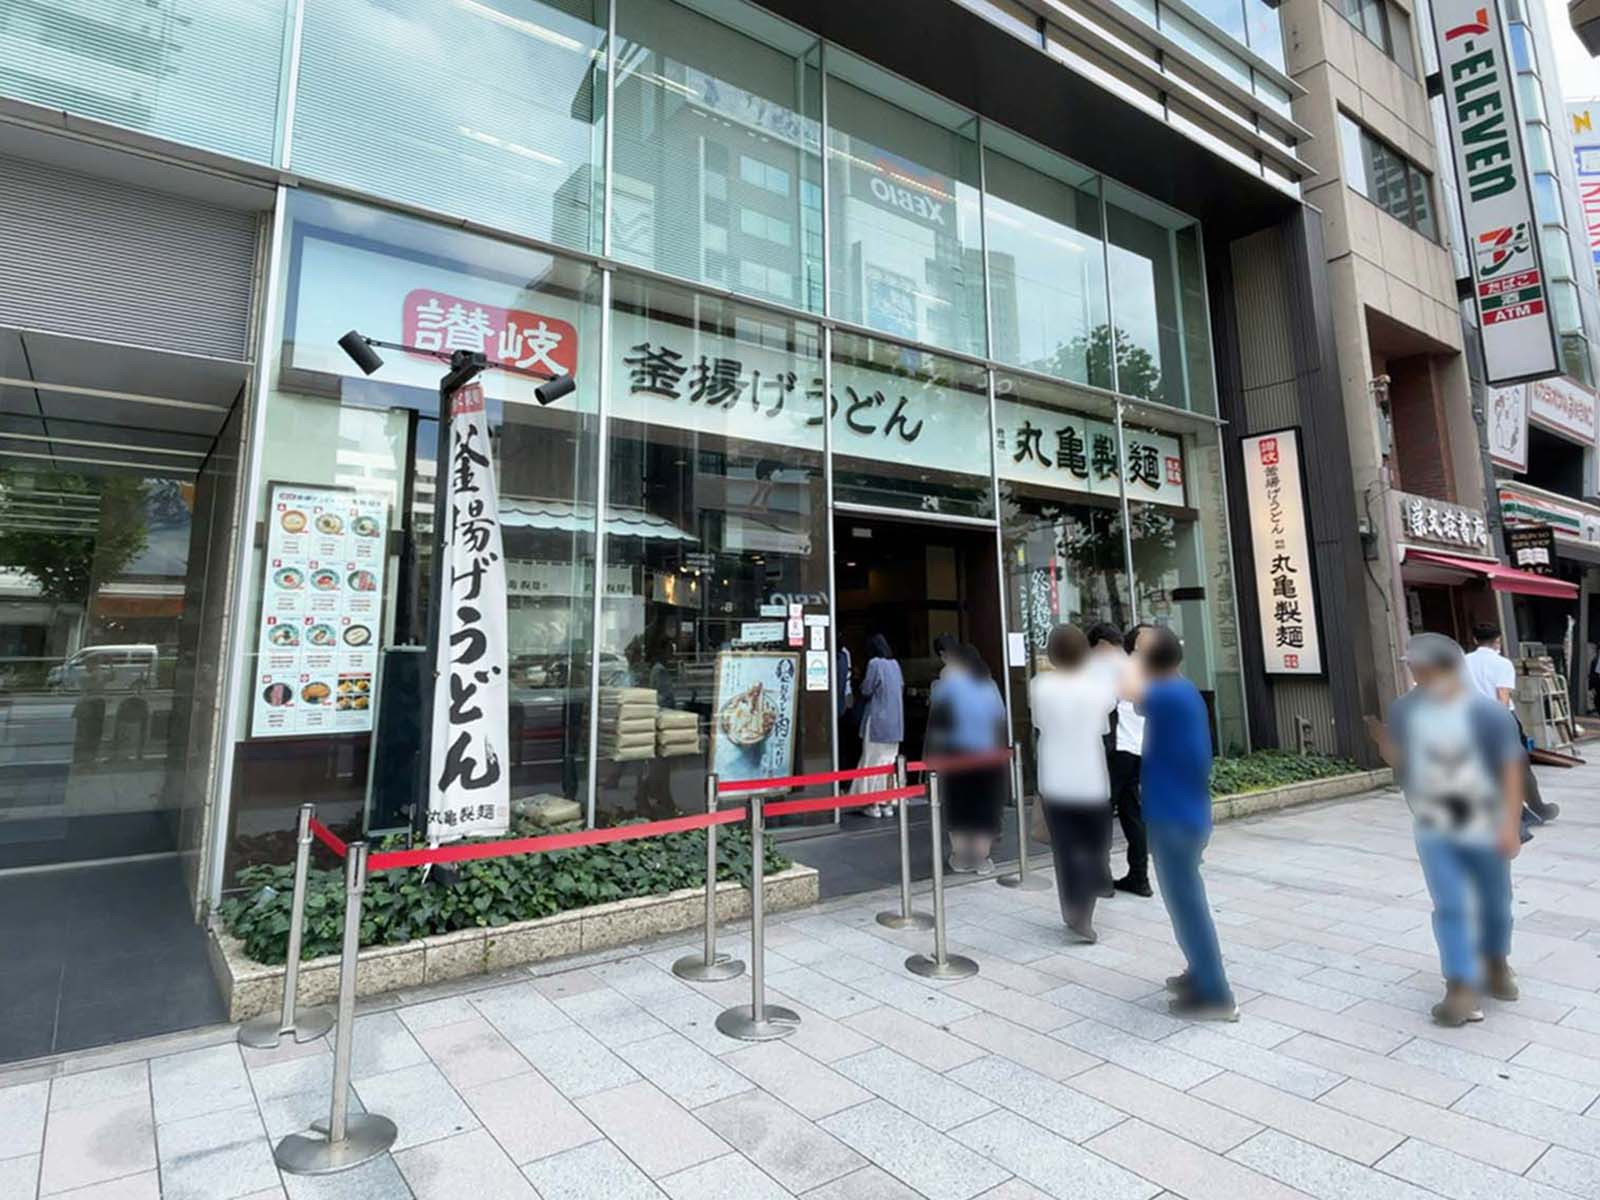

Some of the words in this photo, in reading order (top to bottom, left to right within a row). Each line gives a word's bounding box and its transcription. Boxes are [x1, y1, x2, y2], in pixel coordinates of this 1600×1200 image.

[1494, 304, 1532, 322] ATM
[414, 298, 569, 376] 讃岐
[623, 342, 923, 442] 釜揚げうどん
[1013, 419, 1162, 491] 丸亀製麺
[437, 422, 502, 793] 釜揚げうどん
[1269, 553, 1305, 649] 丸亀製麺
